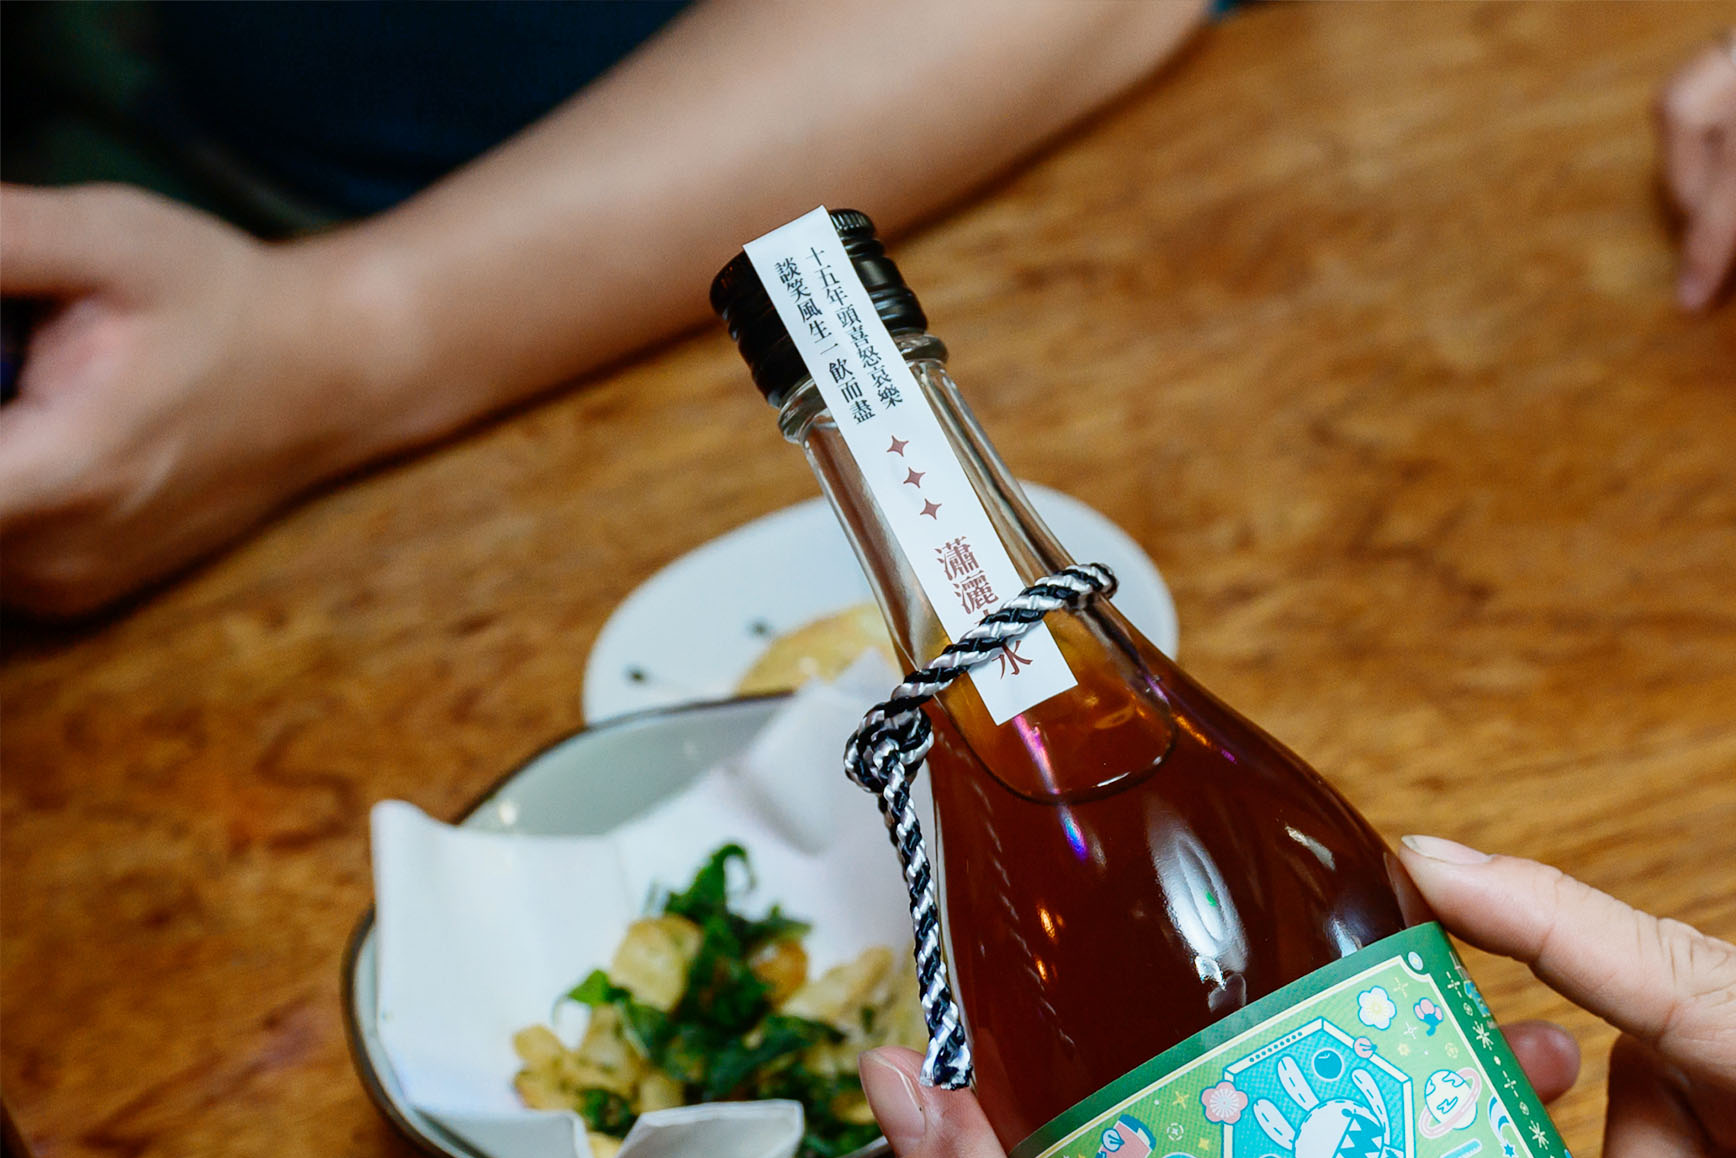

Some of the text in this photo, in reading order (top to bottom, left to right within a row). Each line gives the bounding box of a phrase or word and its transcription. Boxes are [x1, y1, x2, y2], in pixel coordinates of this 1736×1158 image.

[775, 257, 876, 424] 談笑風生一飲而盡
[806, 247, 903, 409] 十五年頭喜怒哀樂
[935, 536, 1033, 680] 瀟灑水
